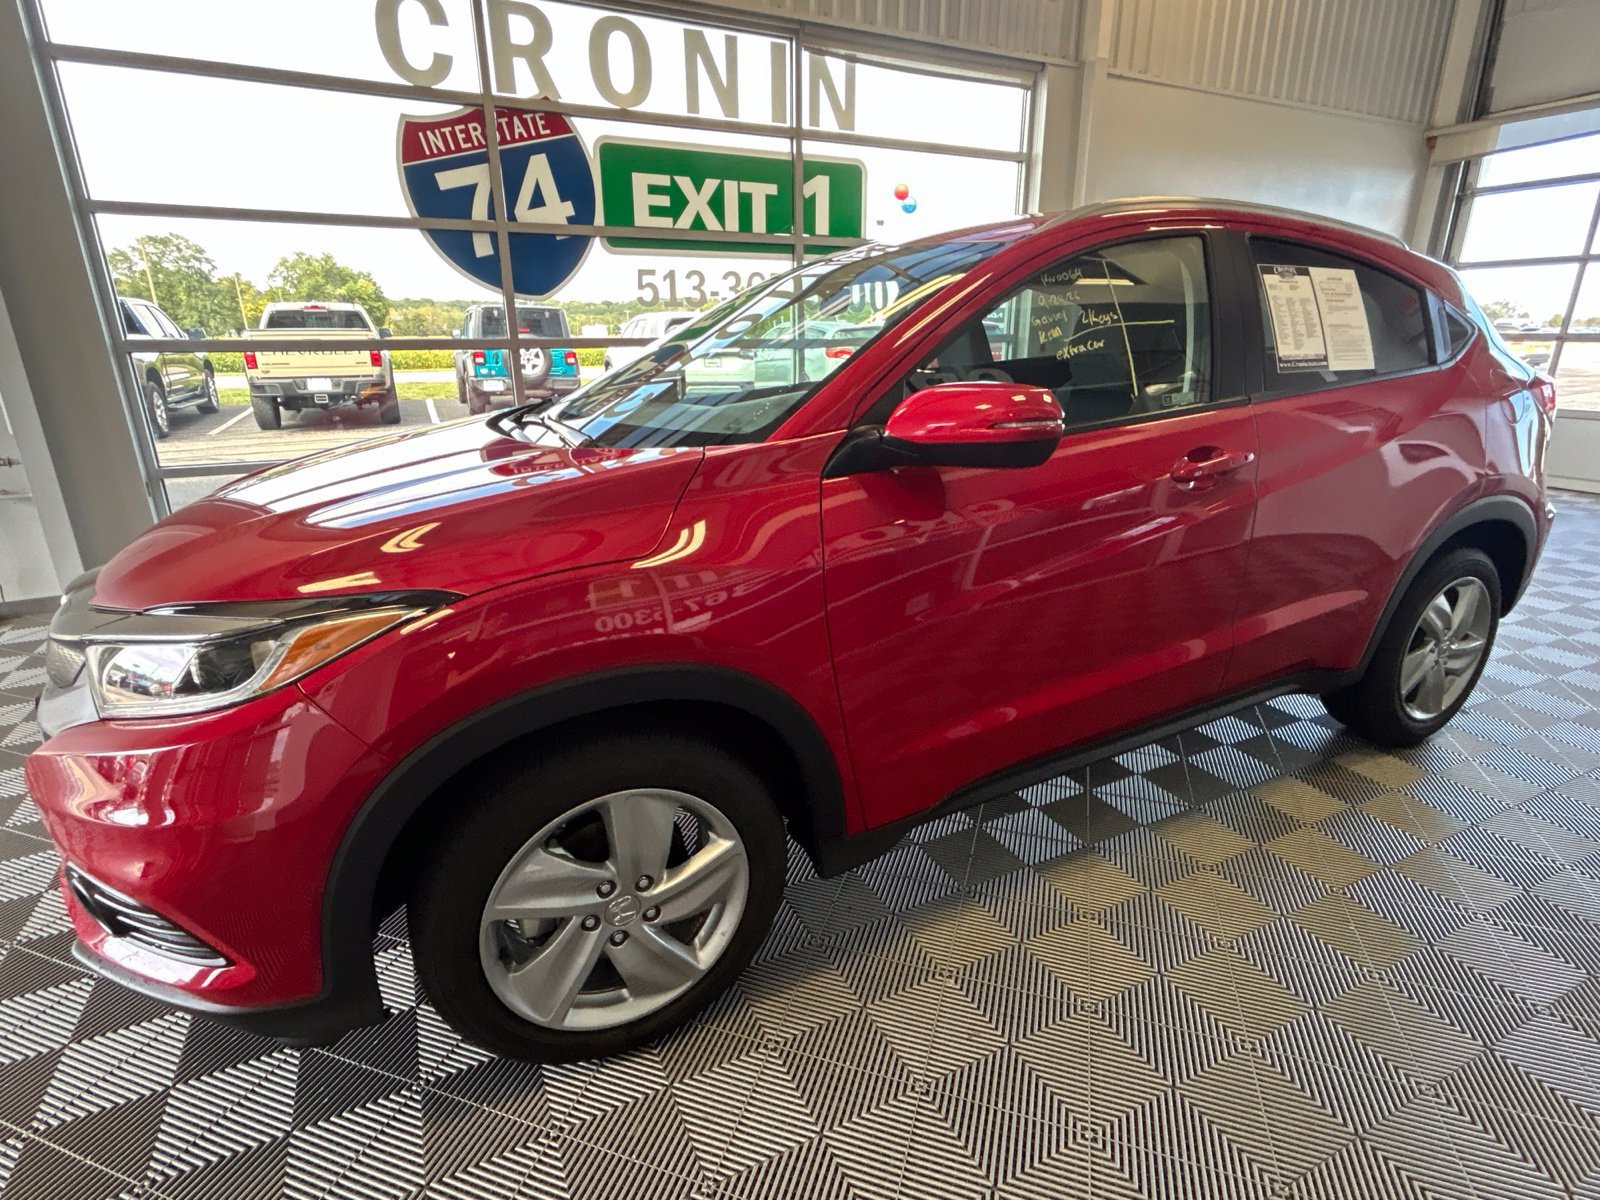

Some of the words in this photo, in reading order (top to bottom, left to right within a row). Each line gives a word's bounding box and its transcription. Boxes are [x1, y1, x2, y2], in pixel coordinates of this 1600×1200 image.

[375, 0, 856, 131] CRONIN
[418, 112, 551, 156] INTERTATE
[434, 152, 576, 258] 74
[631, 171, 778, 234] EXIT
[803, 174, 830, 236] 1
